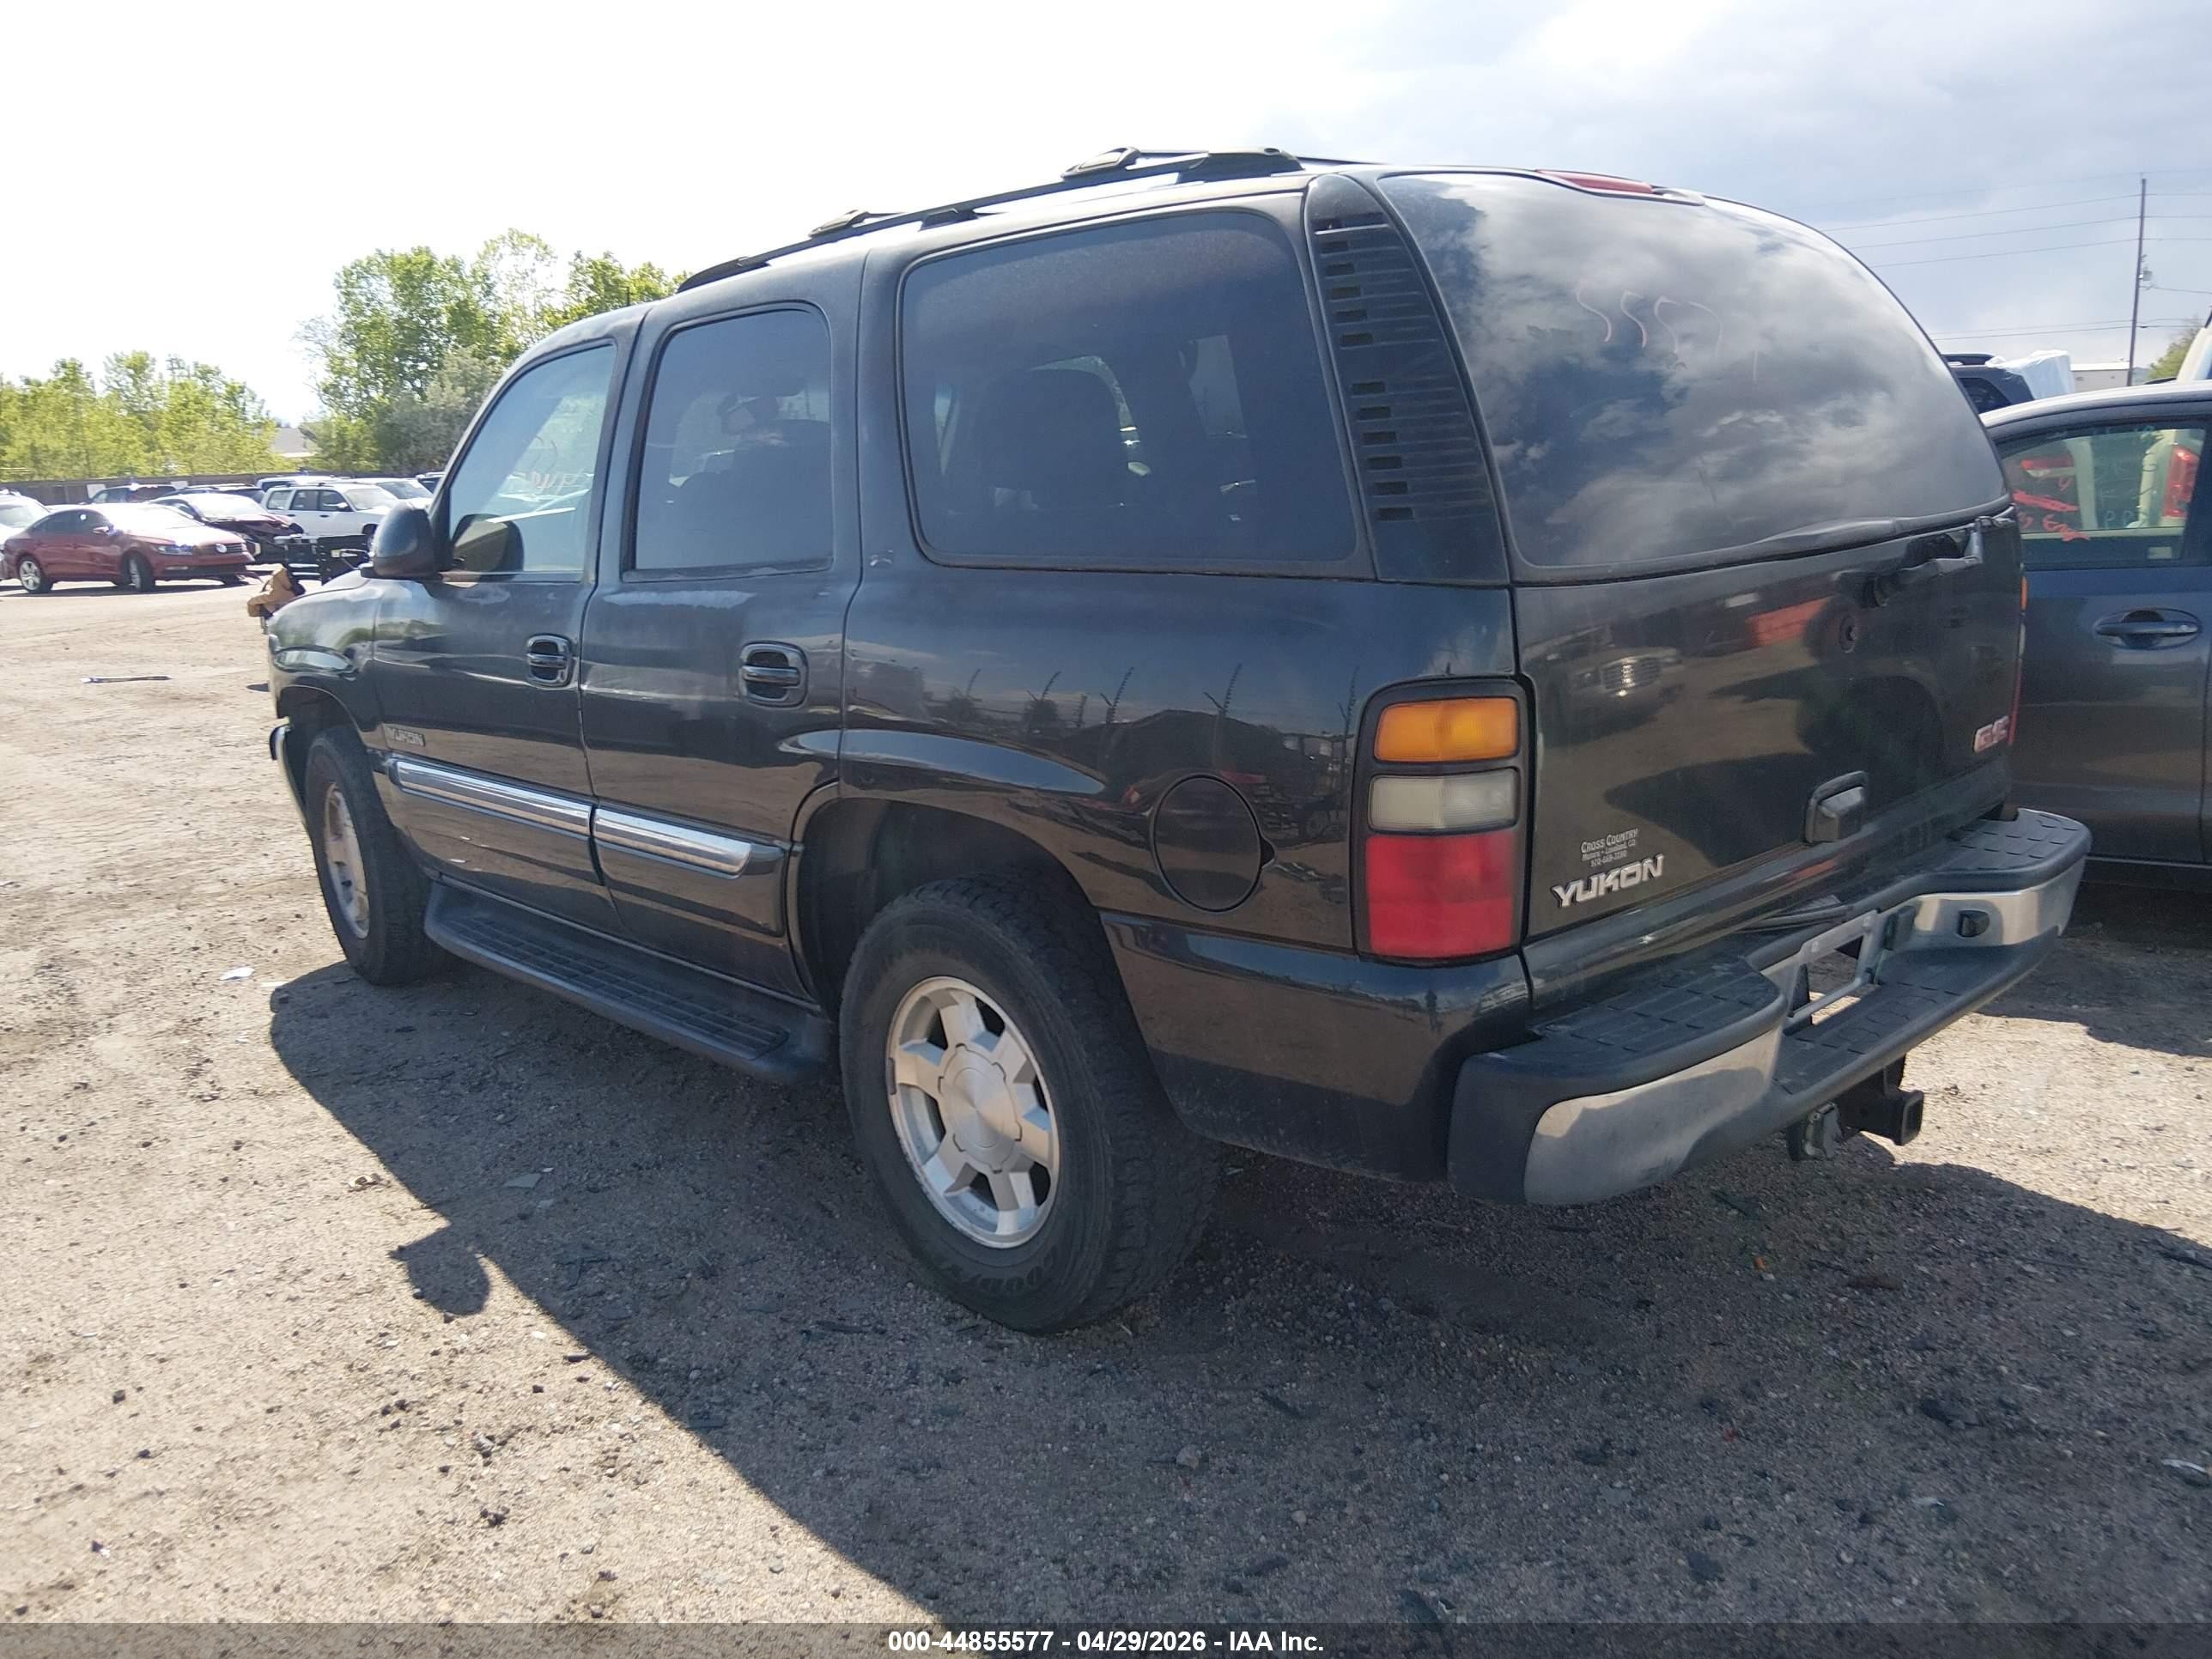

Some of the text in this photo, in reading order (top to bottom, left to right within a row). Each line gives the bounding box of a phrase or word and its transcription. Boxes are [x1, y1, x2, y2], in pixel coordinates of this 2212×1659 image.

[1581, 828, 1638, 854] CROSS COUNTRY
[1552, 854, 1664, 908] YUKON
